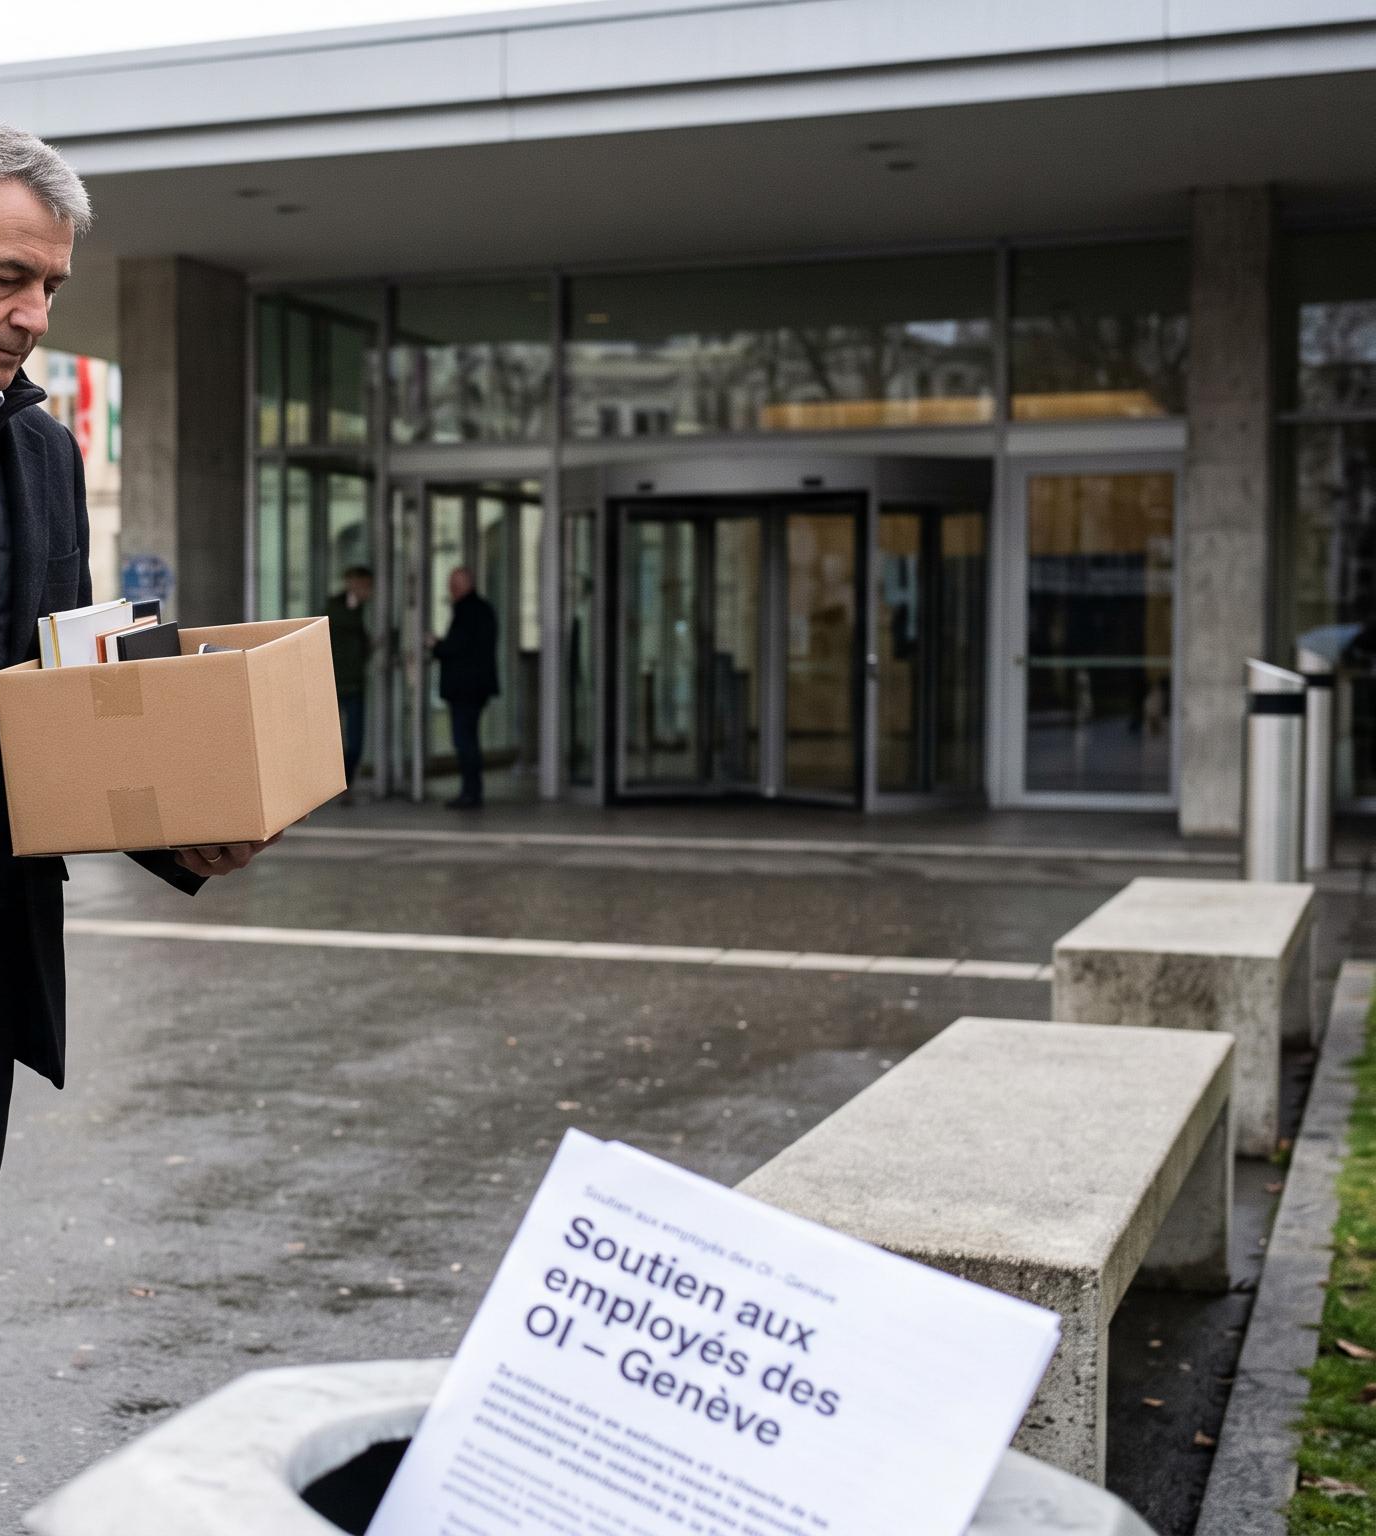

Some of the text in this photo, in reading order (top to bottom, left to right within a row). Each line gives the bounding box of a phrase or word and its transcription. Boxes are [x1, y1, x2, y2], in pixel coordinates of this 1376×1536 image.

[562, 1215, 817, 1354] Soutien aux
[584, 1184, 633, 1214] Soutien
[636, 1210, 659, 1228] aux
[729, 1251, 754, 1269] des
[524, 1303, 575, 1349] OI
[617, 1347, 782, 1447] Genève
[543, 1266, 841, 1418] employés des
